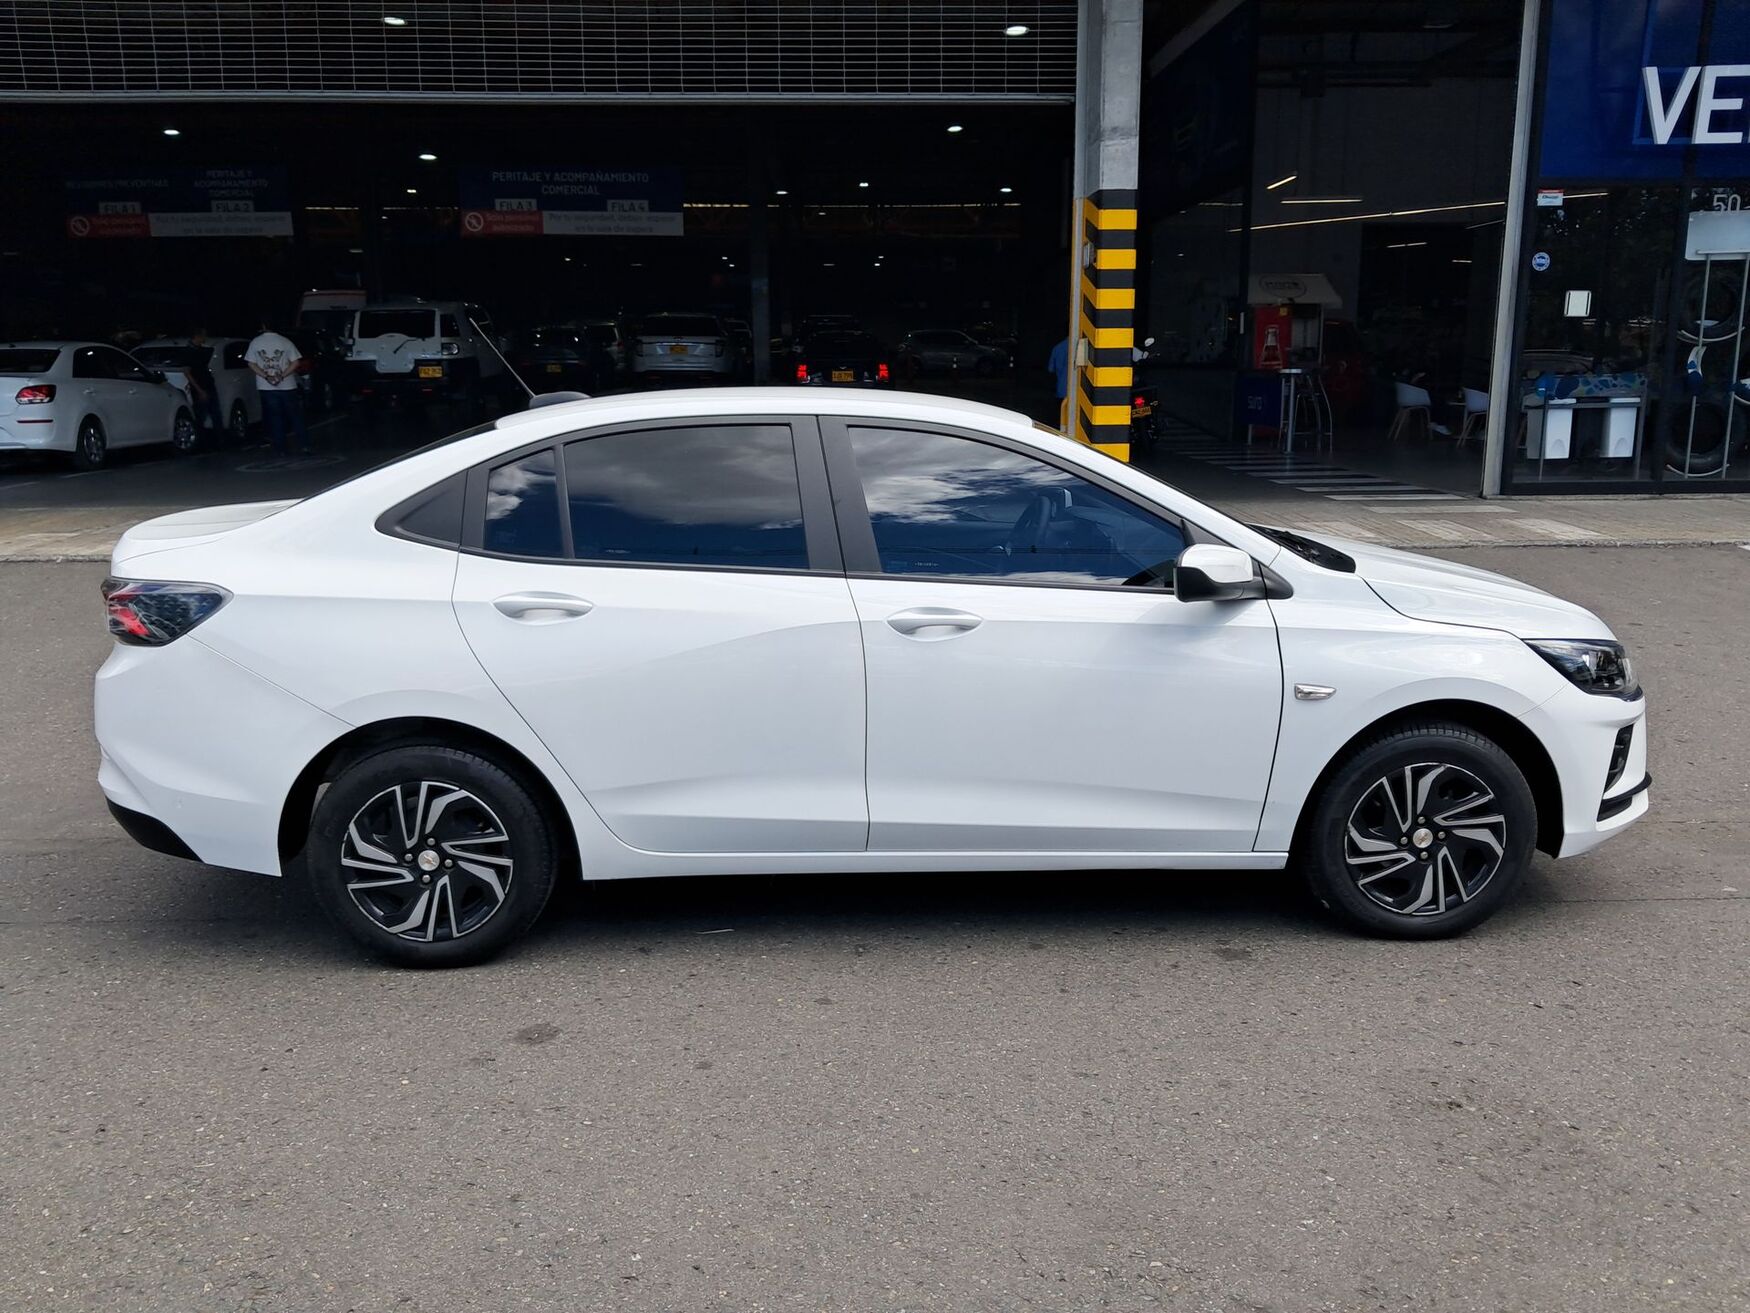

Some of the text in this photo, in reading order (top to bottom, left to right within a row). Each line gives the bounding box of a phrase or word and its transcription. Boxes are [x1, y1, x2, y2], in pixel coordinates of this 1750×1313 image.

[1642, 63, 1750, 145] VE
[491, 170, 649, 183] PERITAJE Y ACOMPAÑAMIENTO
[541, 184, 600, 195] COMERCIAL
[499, 200, 524, 210] FILA
[610, 201, 637, 212] FILA
